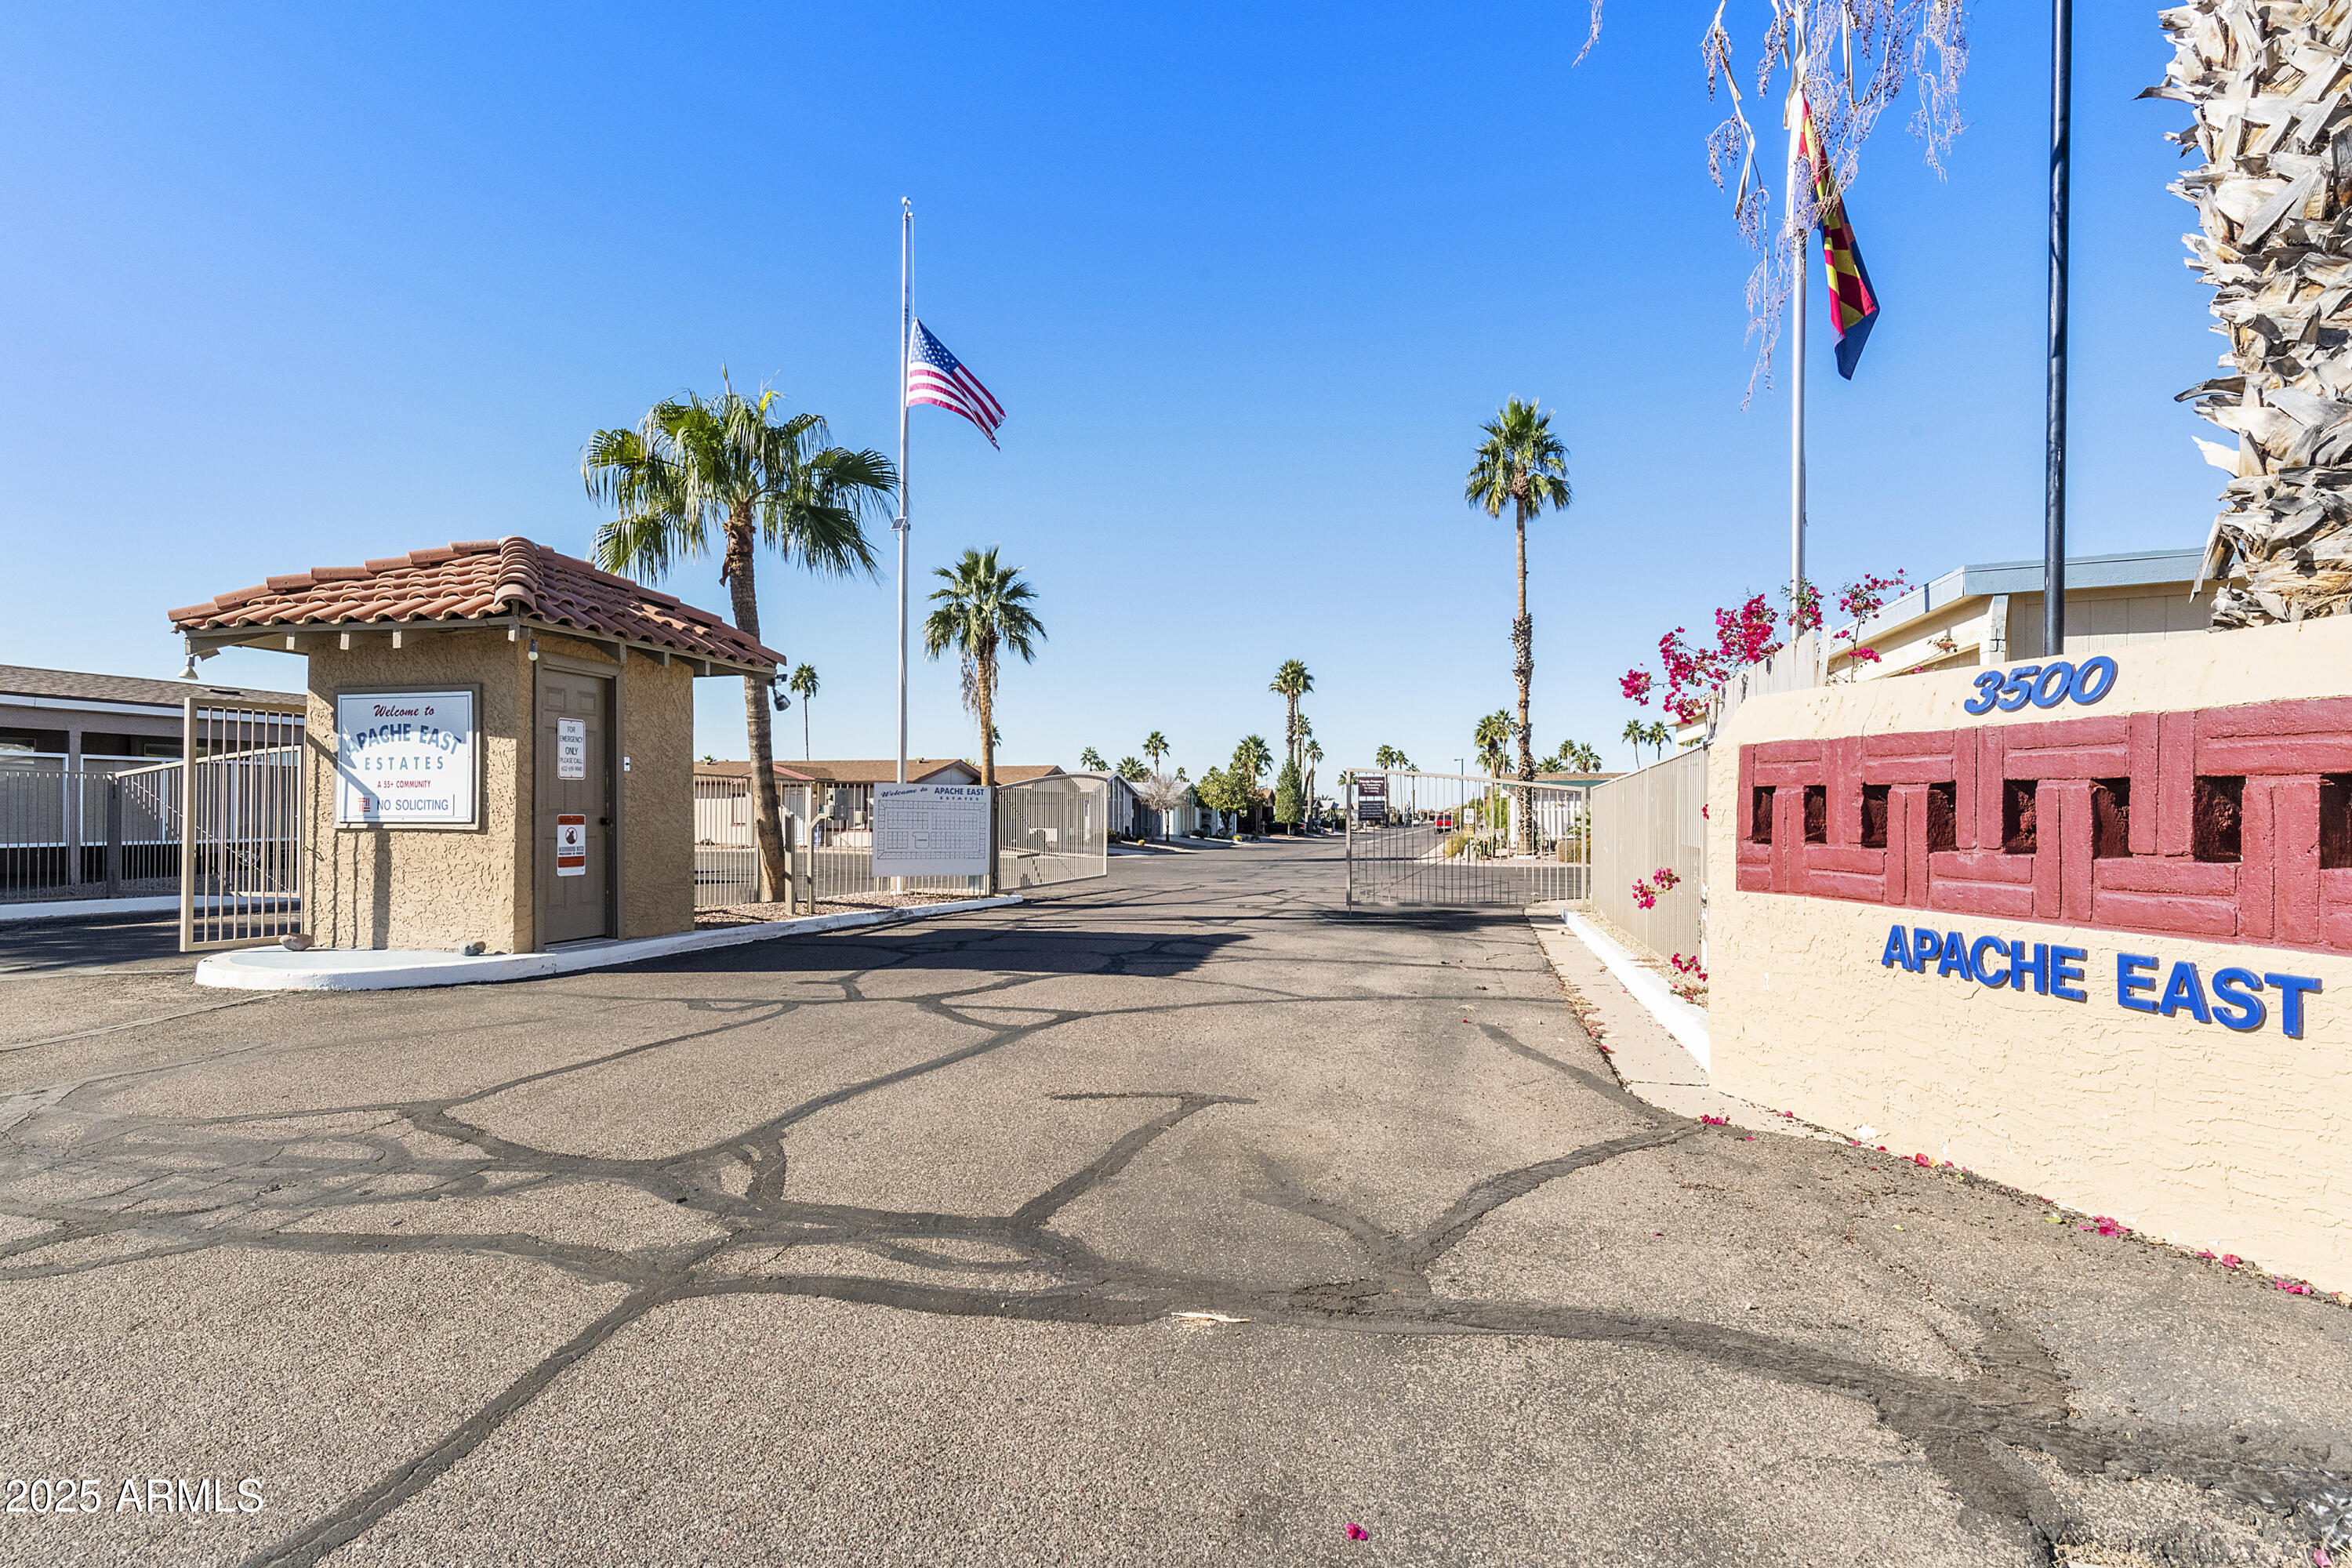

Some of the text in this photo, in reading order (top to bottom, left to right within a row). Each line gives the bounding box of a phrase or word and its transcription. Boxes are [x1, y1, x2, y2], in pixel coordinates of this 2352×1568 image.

[1963, 655, 2118, 716] 3500
[373, 704, 434, 717] Welcome to
[347, 723, 462, 757] APACHE EAST
[559, 735, 583, 743] EMERGENCY
[564, 746, 579, 756] ONLY
[365, 756, 444, 771] ESTATES
[396, 779, 431, 789] COMMUNITY
[880, 789, 917, 797] Welcome
[376, 799, 448, 811] NO SOLICITING
[1882, 924, 2323, 1039] APACHE EAST
